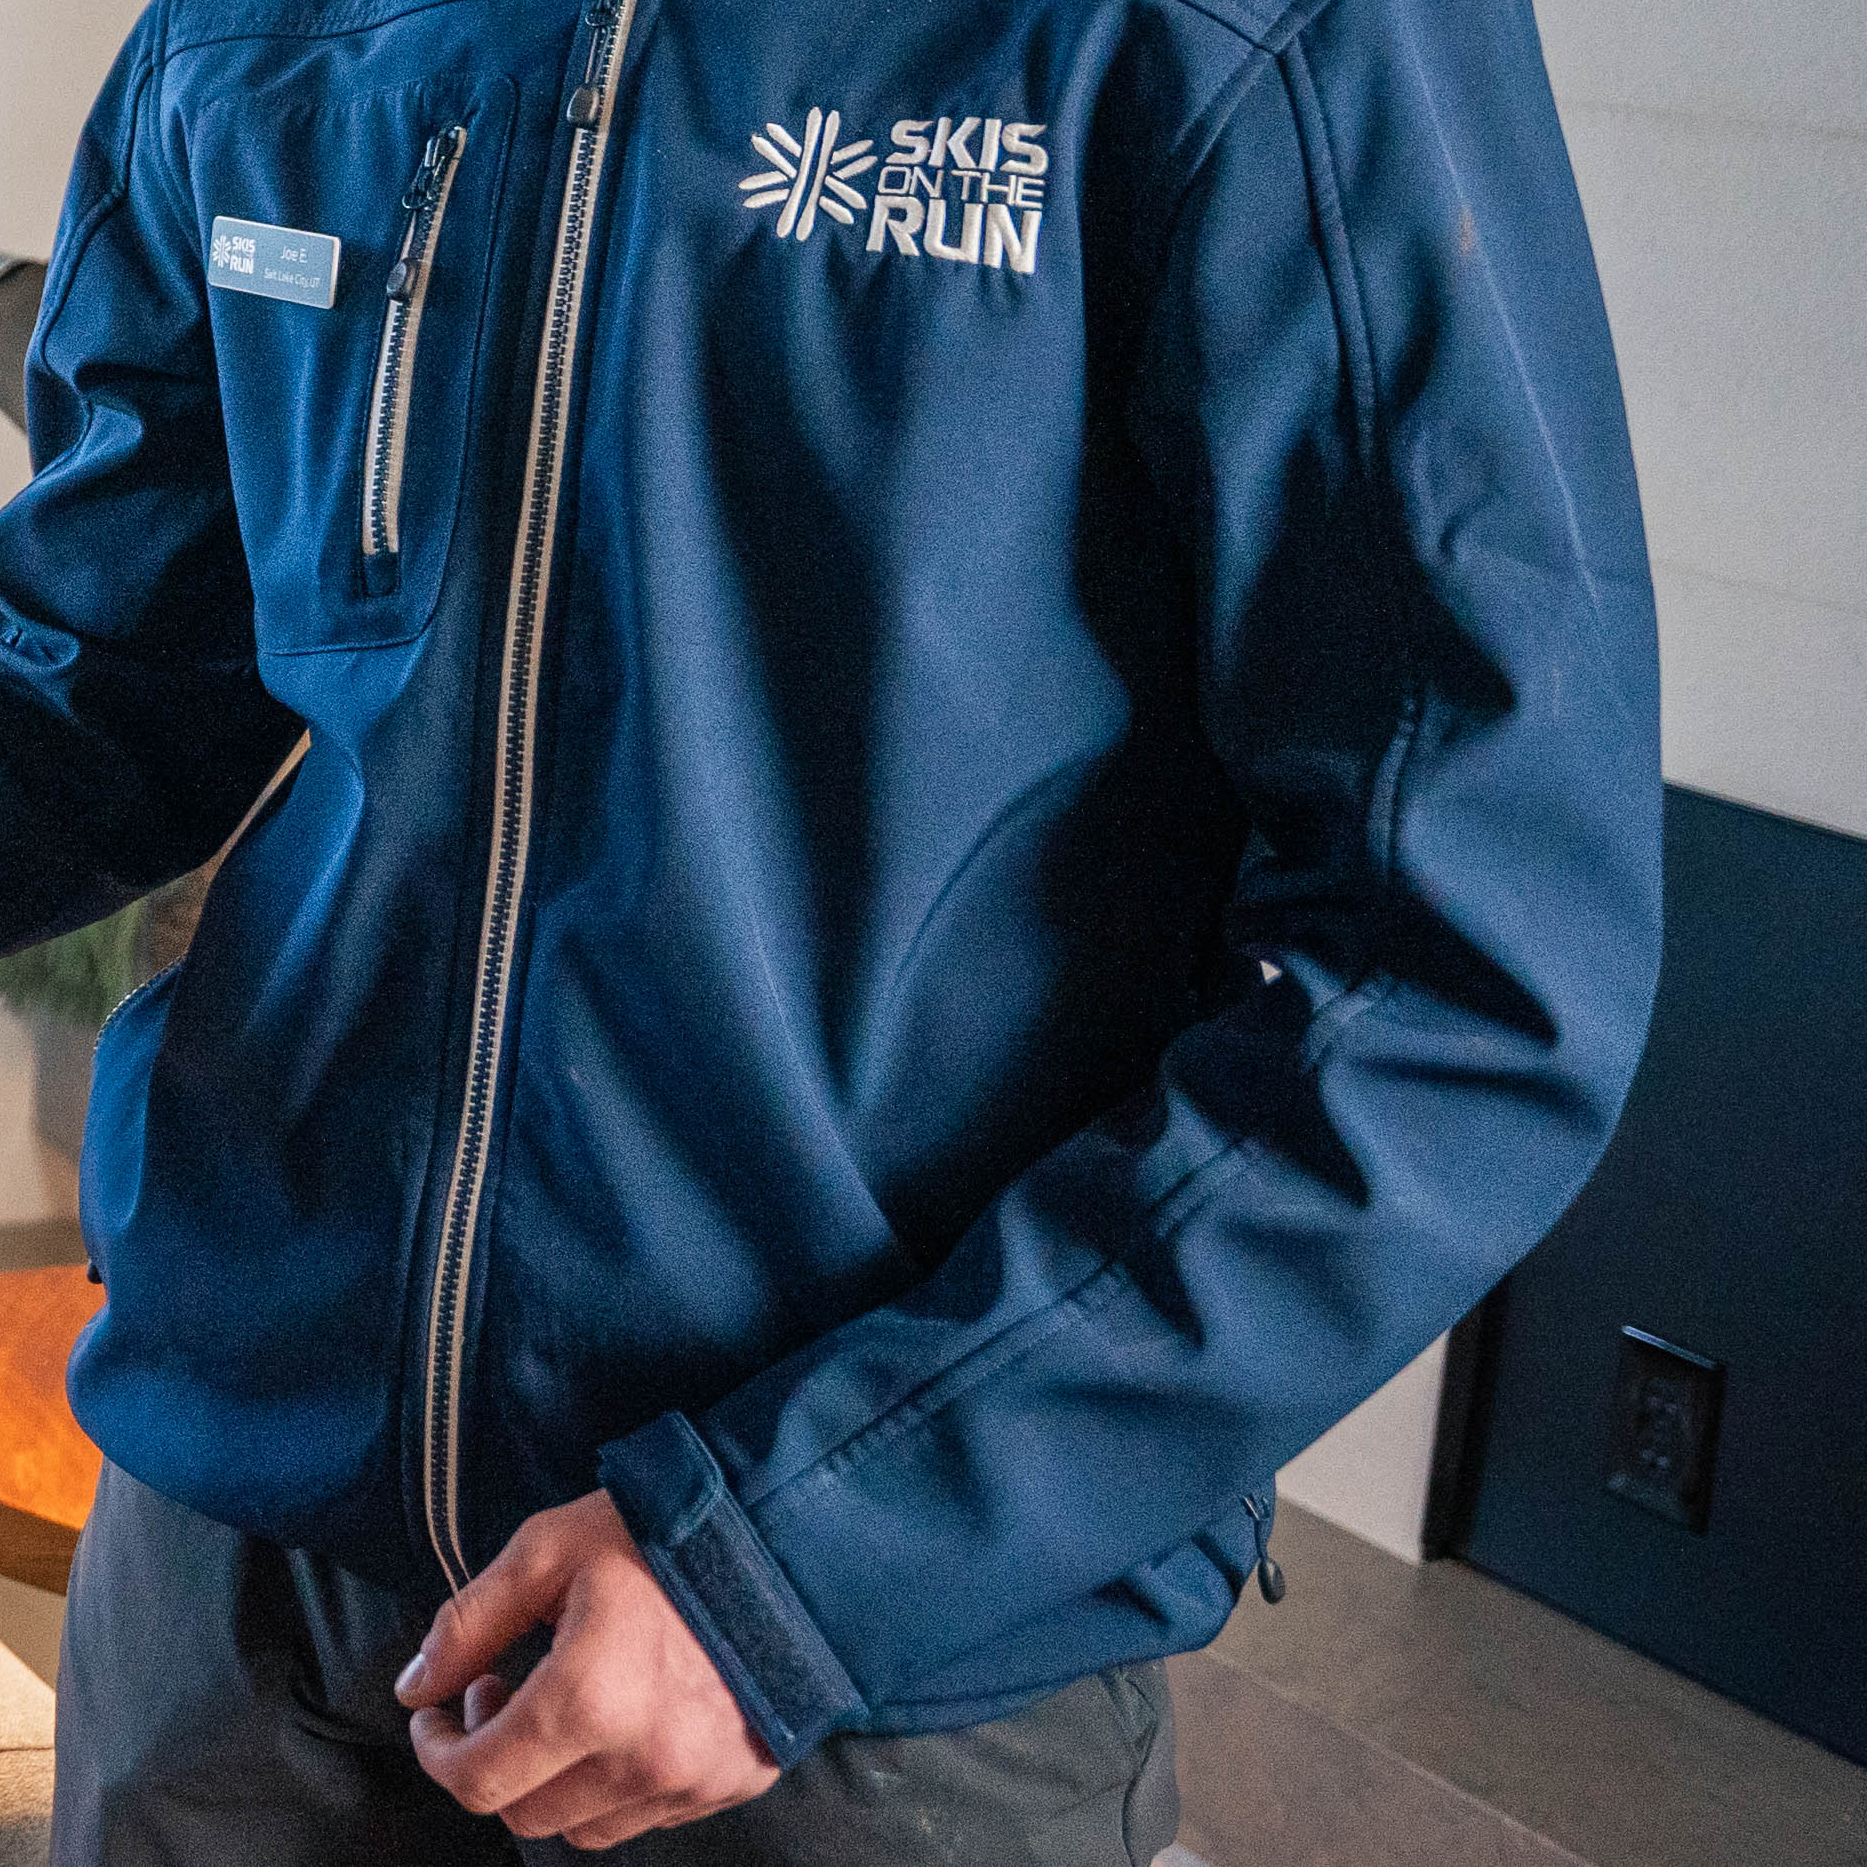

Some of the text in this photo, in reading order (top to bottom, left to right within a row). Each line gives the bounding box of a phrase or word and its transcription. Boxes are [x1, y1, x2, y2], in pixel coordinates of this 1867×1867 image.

[885, 117, 1048, 174] SKIS
[878, 165, 1046, 209] ON THE
[231, 236, 256, 252] SKIS
[866, 194, 1043, 274] RUN
[230, 256, 254, 274] RUN
[280, 246, 298, 262] Joe
